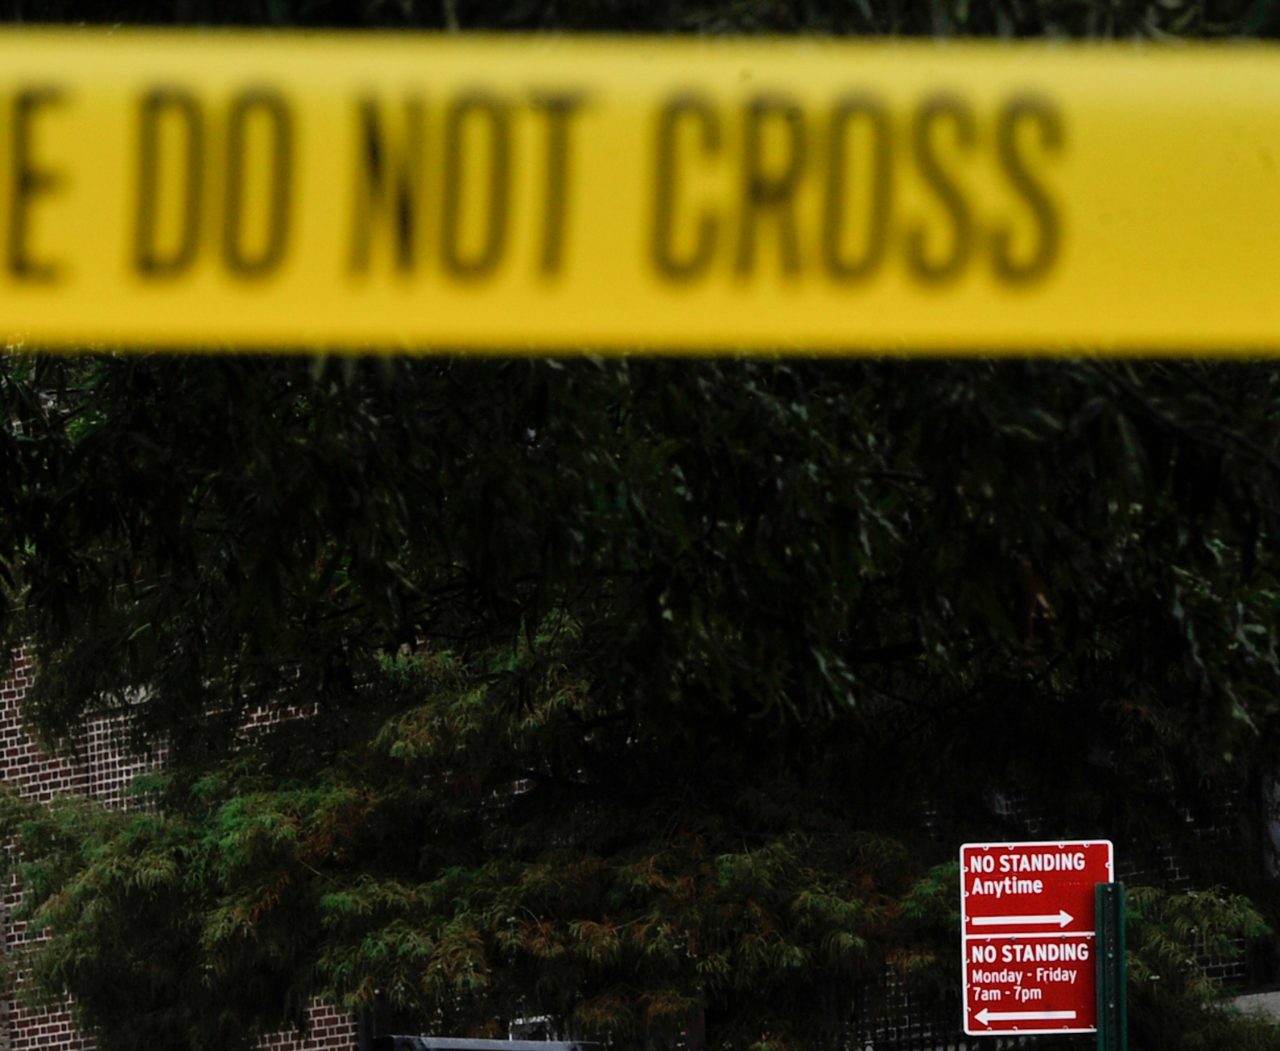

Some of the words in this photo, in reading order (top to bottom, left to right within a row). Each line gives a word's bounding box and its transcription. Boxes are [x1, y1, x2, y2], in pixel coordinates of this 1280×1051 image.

[135, 86, 296, 284] DO
[342, 88, 592, 286] NOT
[647, 90, 1067, 290] CROSS
[970, 855, 995, 873] NO
[999, 853, 1086, 872] STANDING
[972, 877, 1043, 898] Anytime
[972, 946, 997, 963] NO
[1002, 944, 1089, 963] STANDING
[972, 969, 1023, 984] Monday
[1036, 967, 1077, 984] Friday
[973, 987, 1001, 1000] 7am
[1015, 986, 1042, 1003] 7pm
